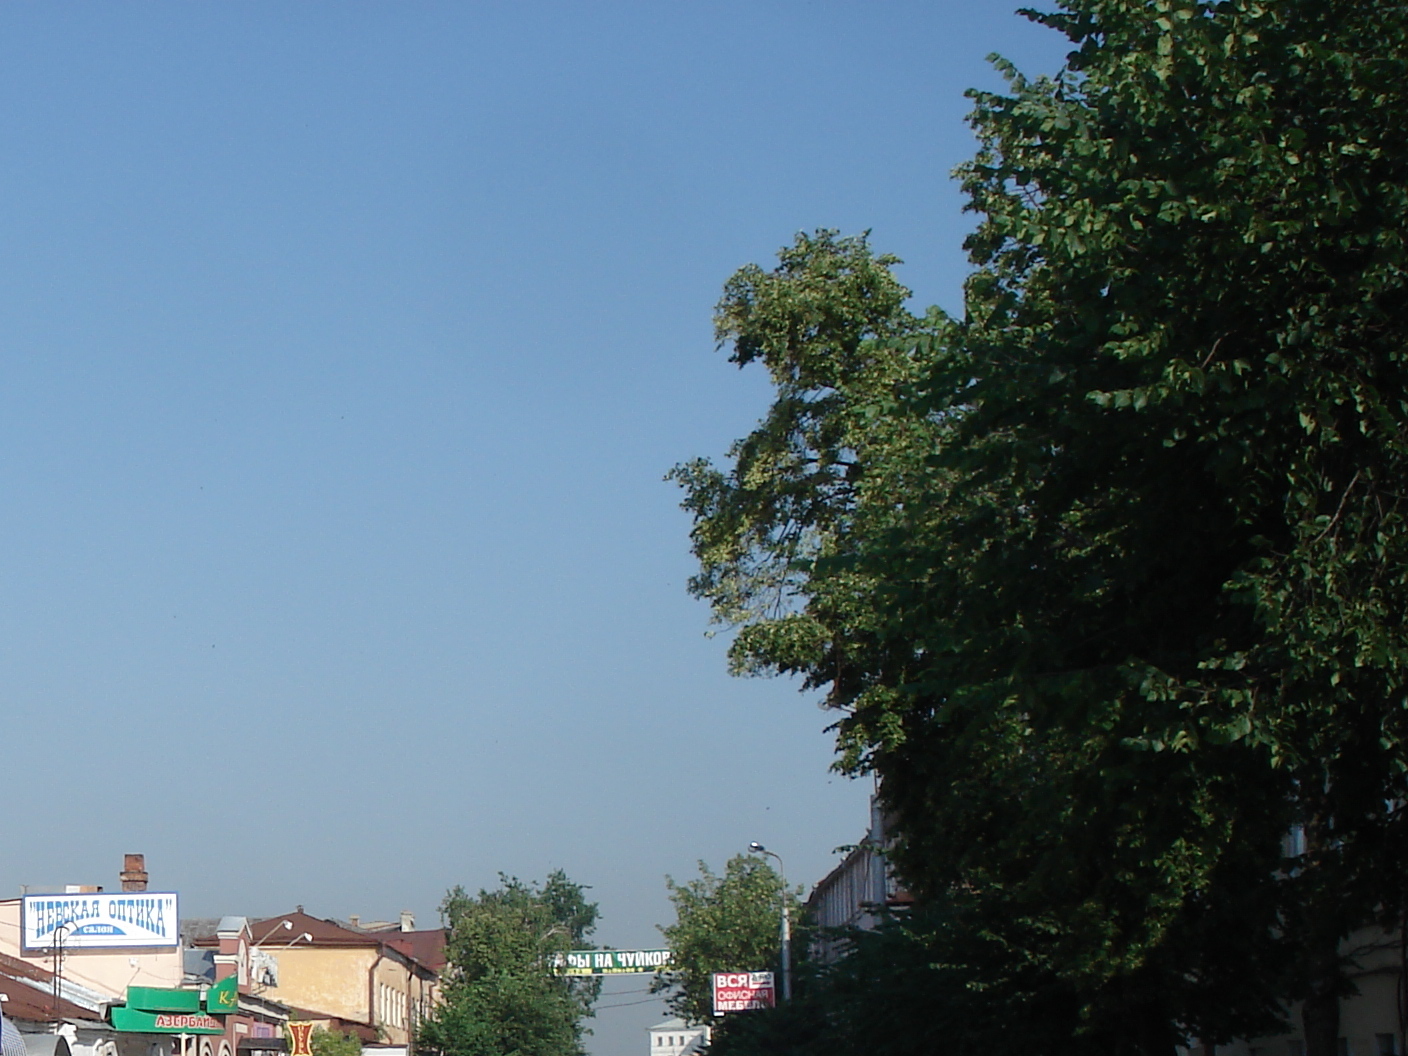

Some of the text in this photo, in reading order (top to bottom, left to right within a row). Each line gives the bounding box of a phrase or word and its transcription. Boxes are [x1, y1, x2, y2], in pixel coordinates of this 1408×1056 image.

[594, 953, 613, 968] НА
[716, 974, 748, 988] ВСЯ
[717, 989, 769, 1001] ОФИСНАЯ
